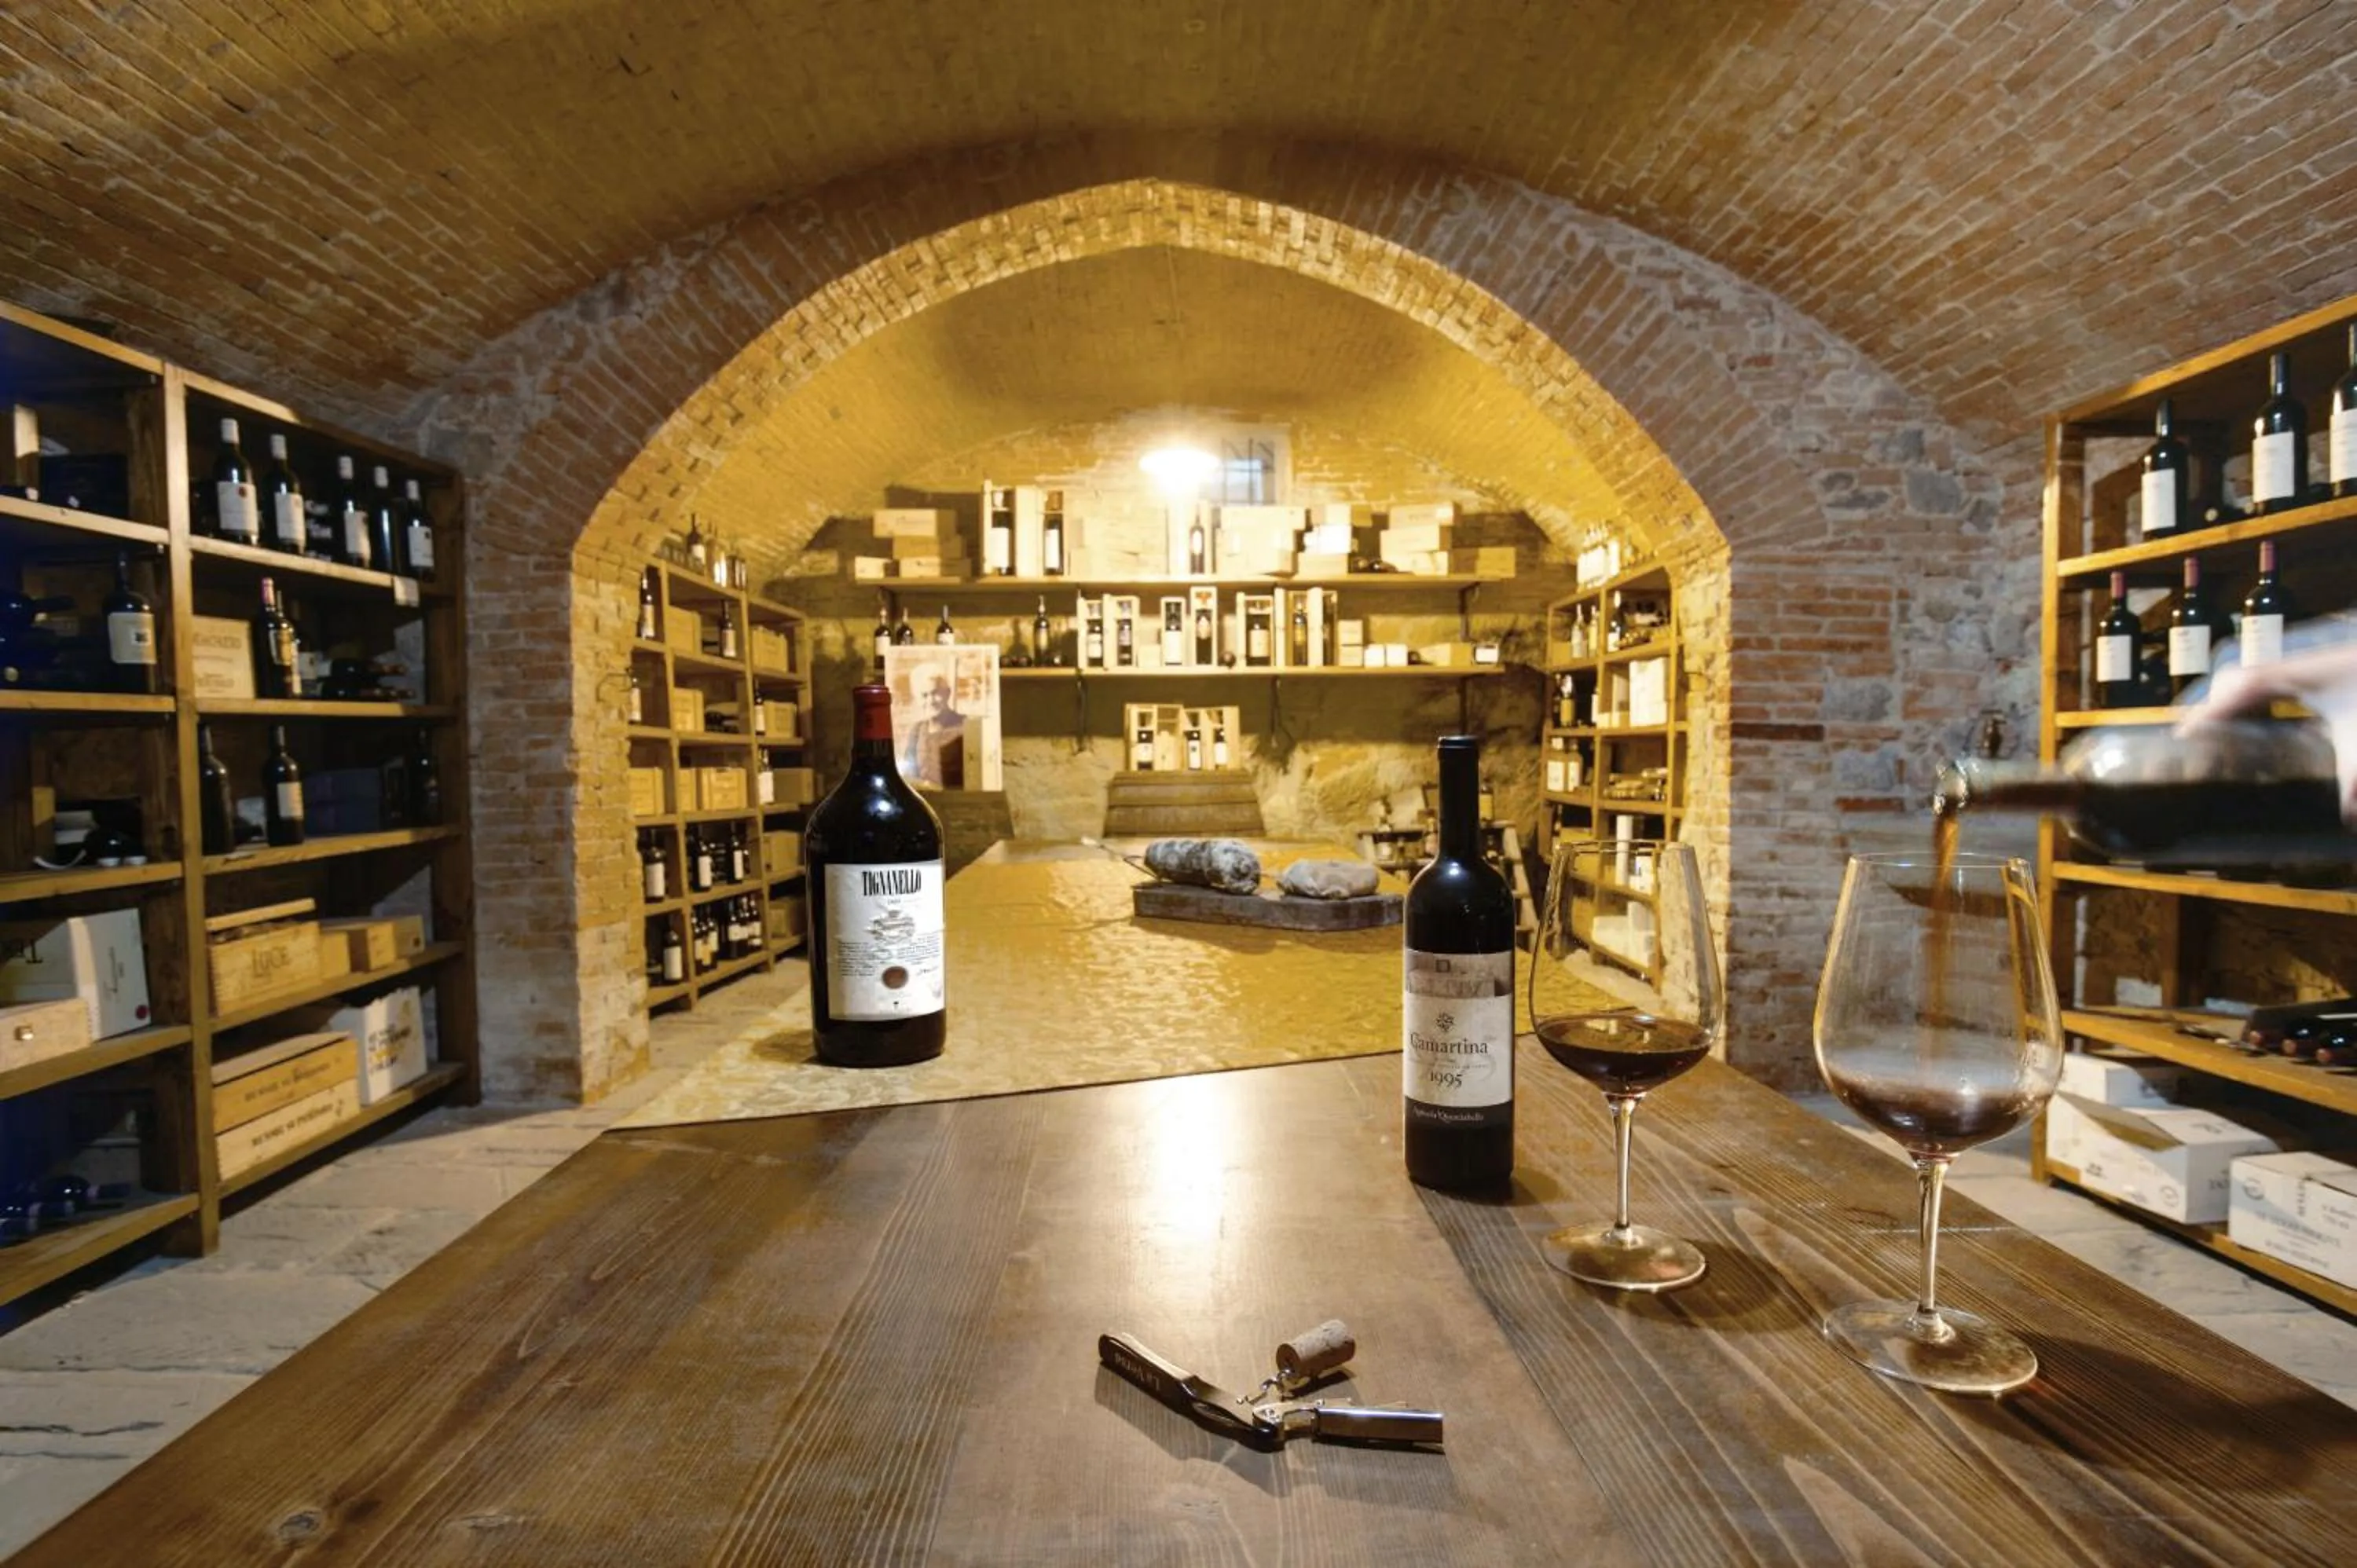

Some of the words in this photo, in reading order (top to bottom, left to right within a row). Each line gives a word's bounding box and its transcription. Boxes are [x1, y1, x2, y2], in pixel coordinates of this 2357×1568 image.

[862, 870, 921, 896] TIGNANELLO
[1410, 1032, 1488, 1054] Camartina
[1430, 1071, 1462, 1088] 1995
